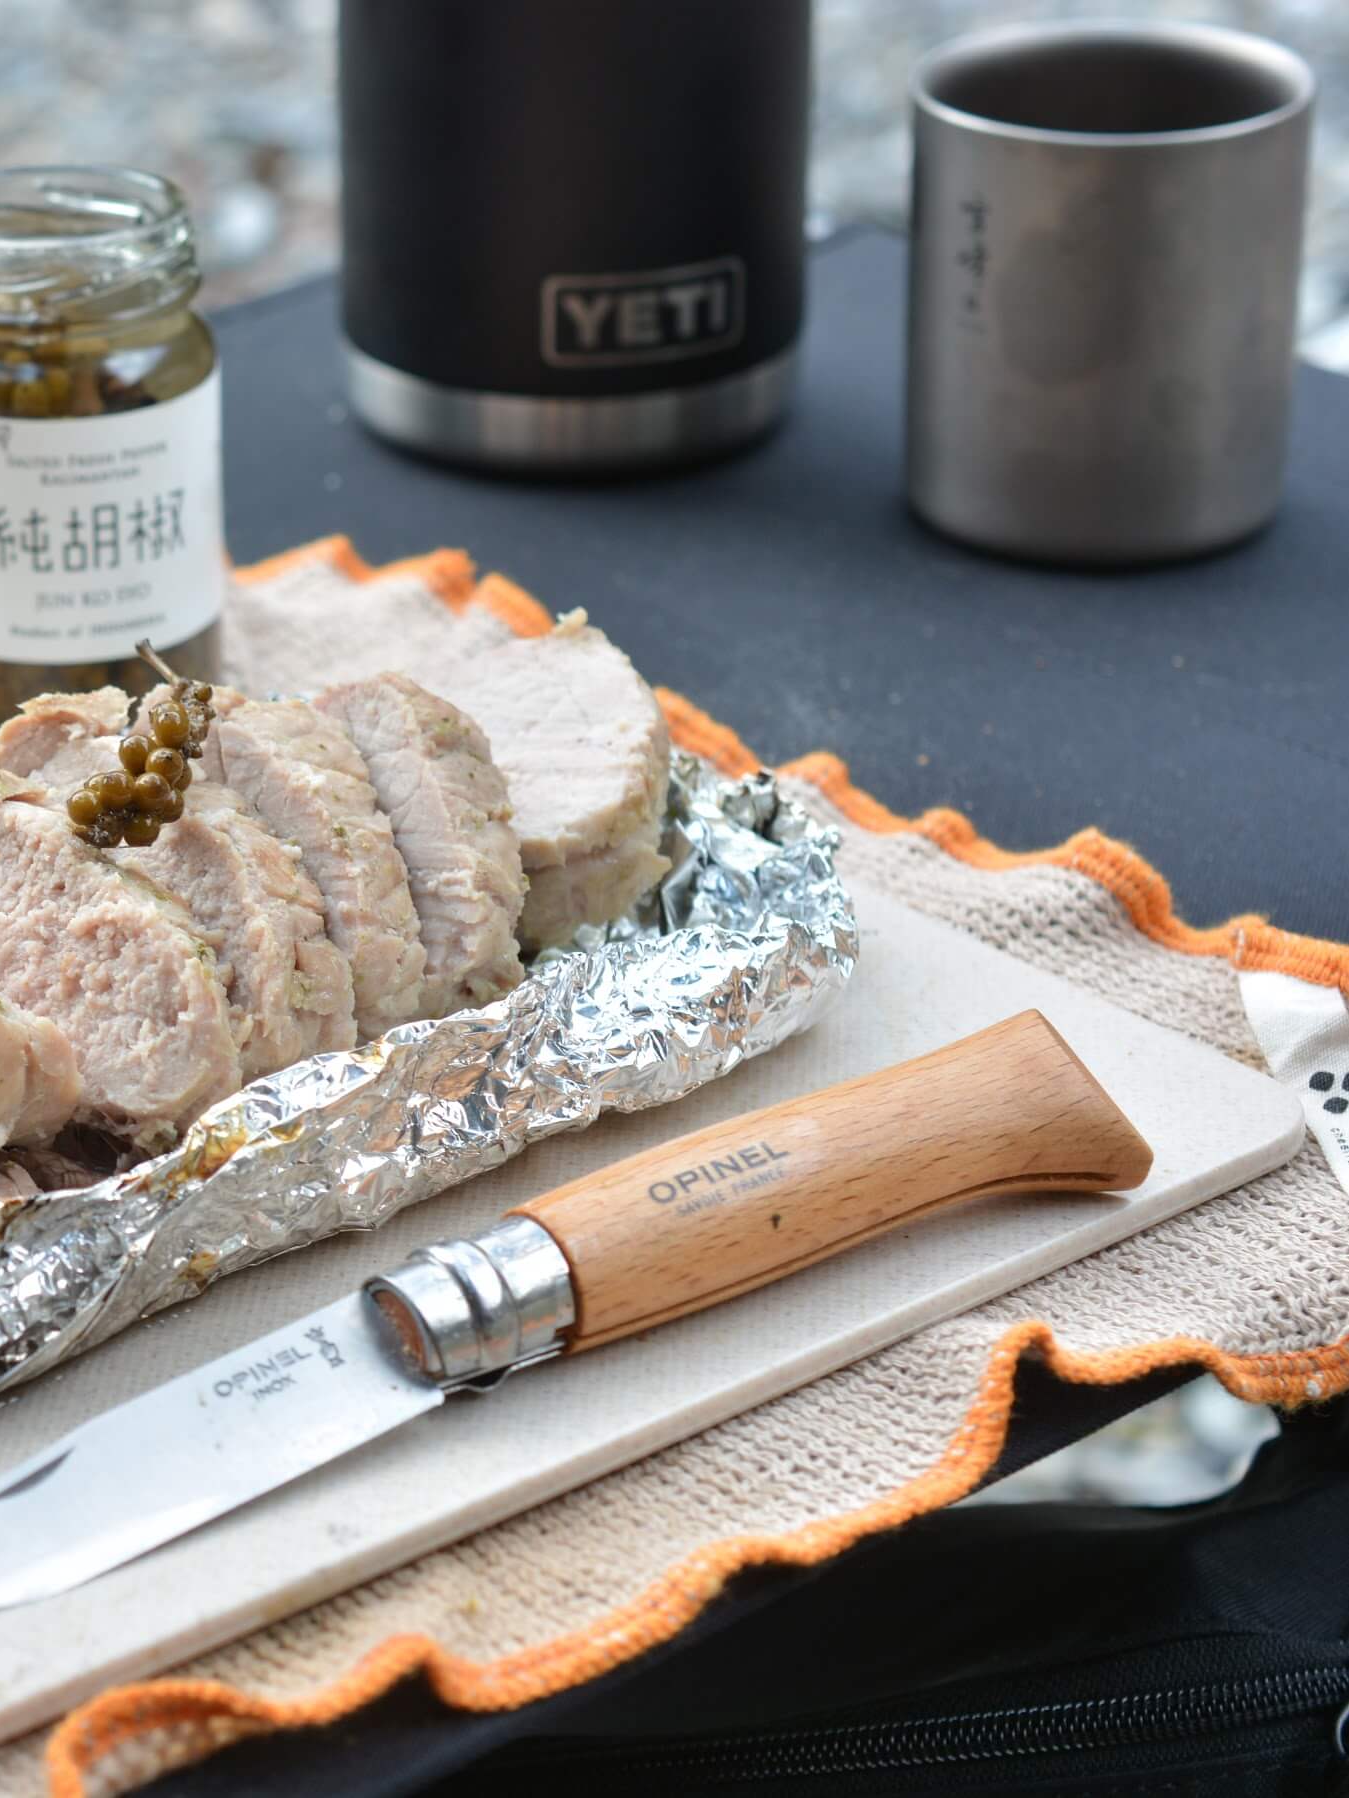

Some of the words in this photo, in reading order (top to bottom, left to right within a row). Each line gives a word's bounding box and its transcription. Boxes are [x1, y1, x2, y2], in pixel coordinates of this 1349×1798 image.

[561, 278, 727, 349] YETI
[647, 1141, 791, 1204] OPINEL
[214, 1346, 313, 1398] OPINEL
[252, 1373, 298, 1401] INOX
